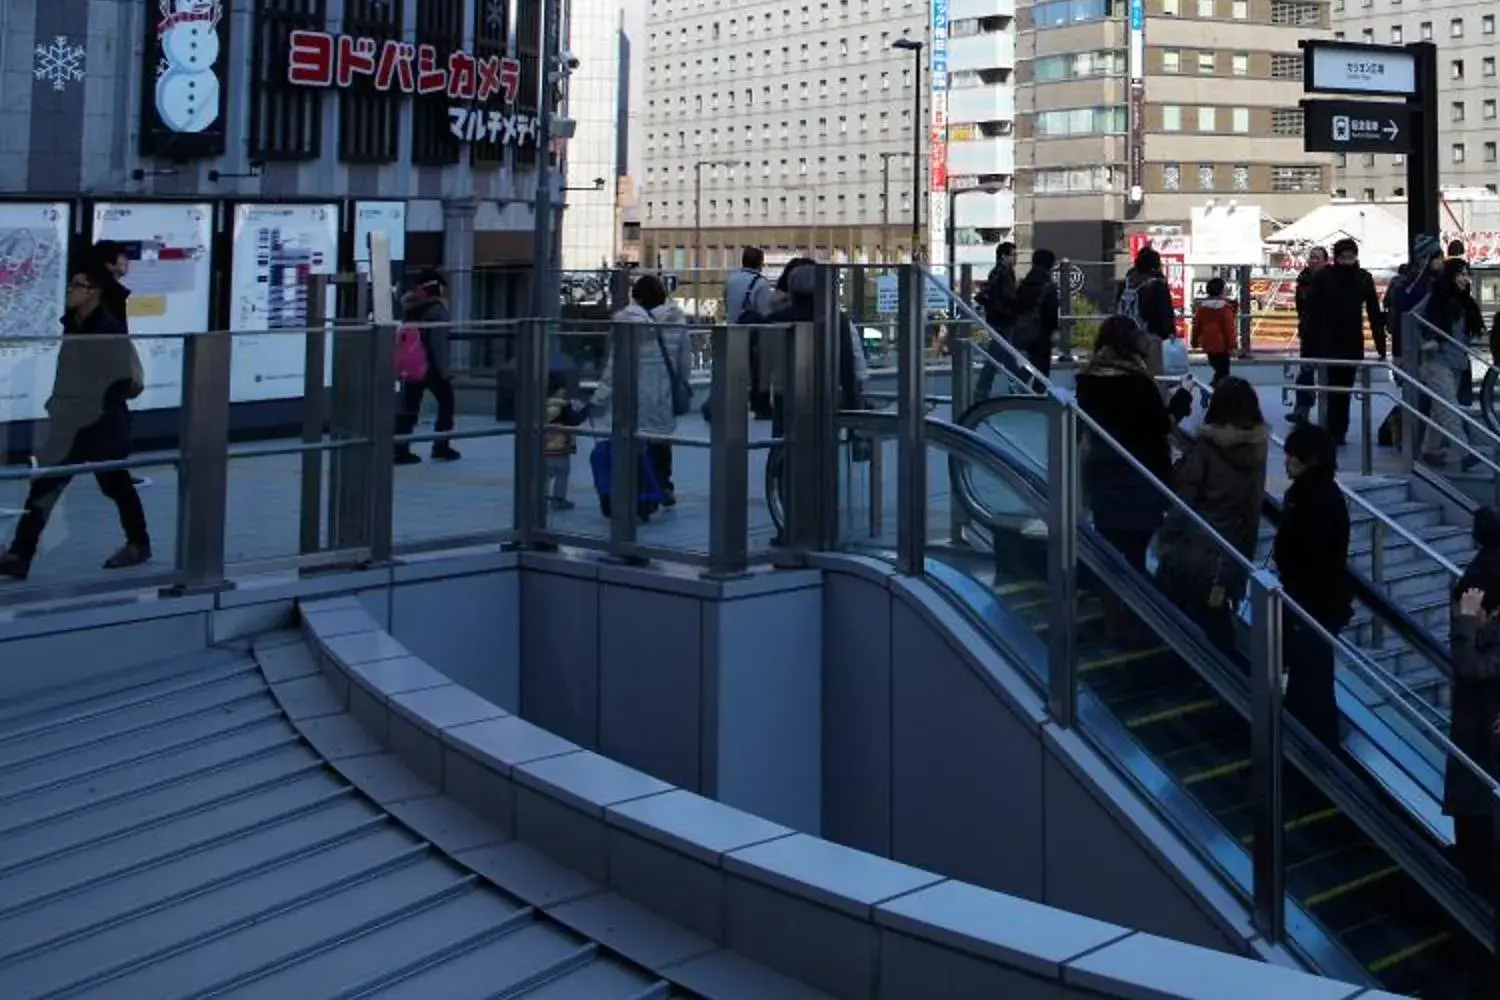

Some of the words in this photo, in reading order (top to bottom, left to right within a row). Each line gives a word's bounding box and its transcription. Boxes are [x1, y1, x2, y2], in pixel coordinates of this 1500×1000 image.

[288, 30, 521, 104] ヨドバシカメラ
[448, 106, 542, 148] マルチメディ
